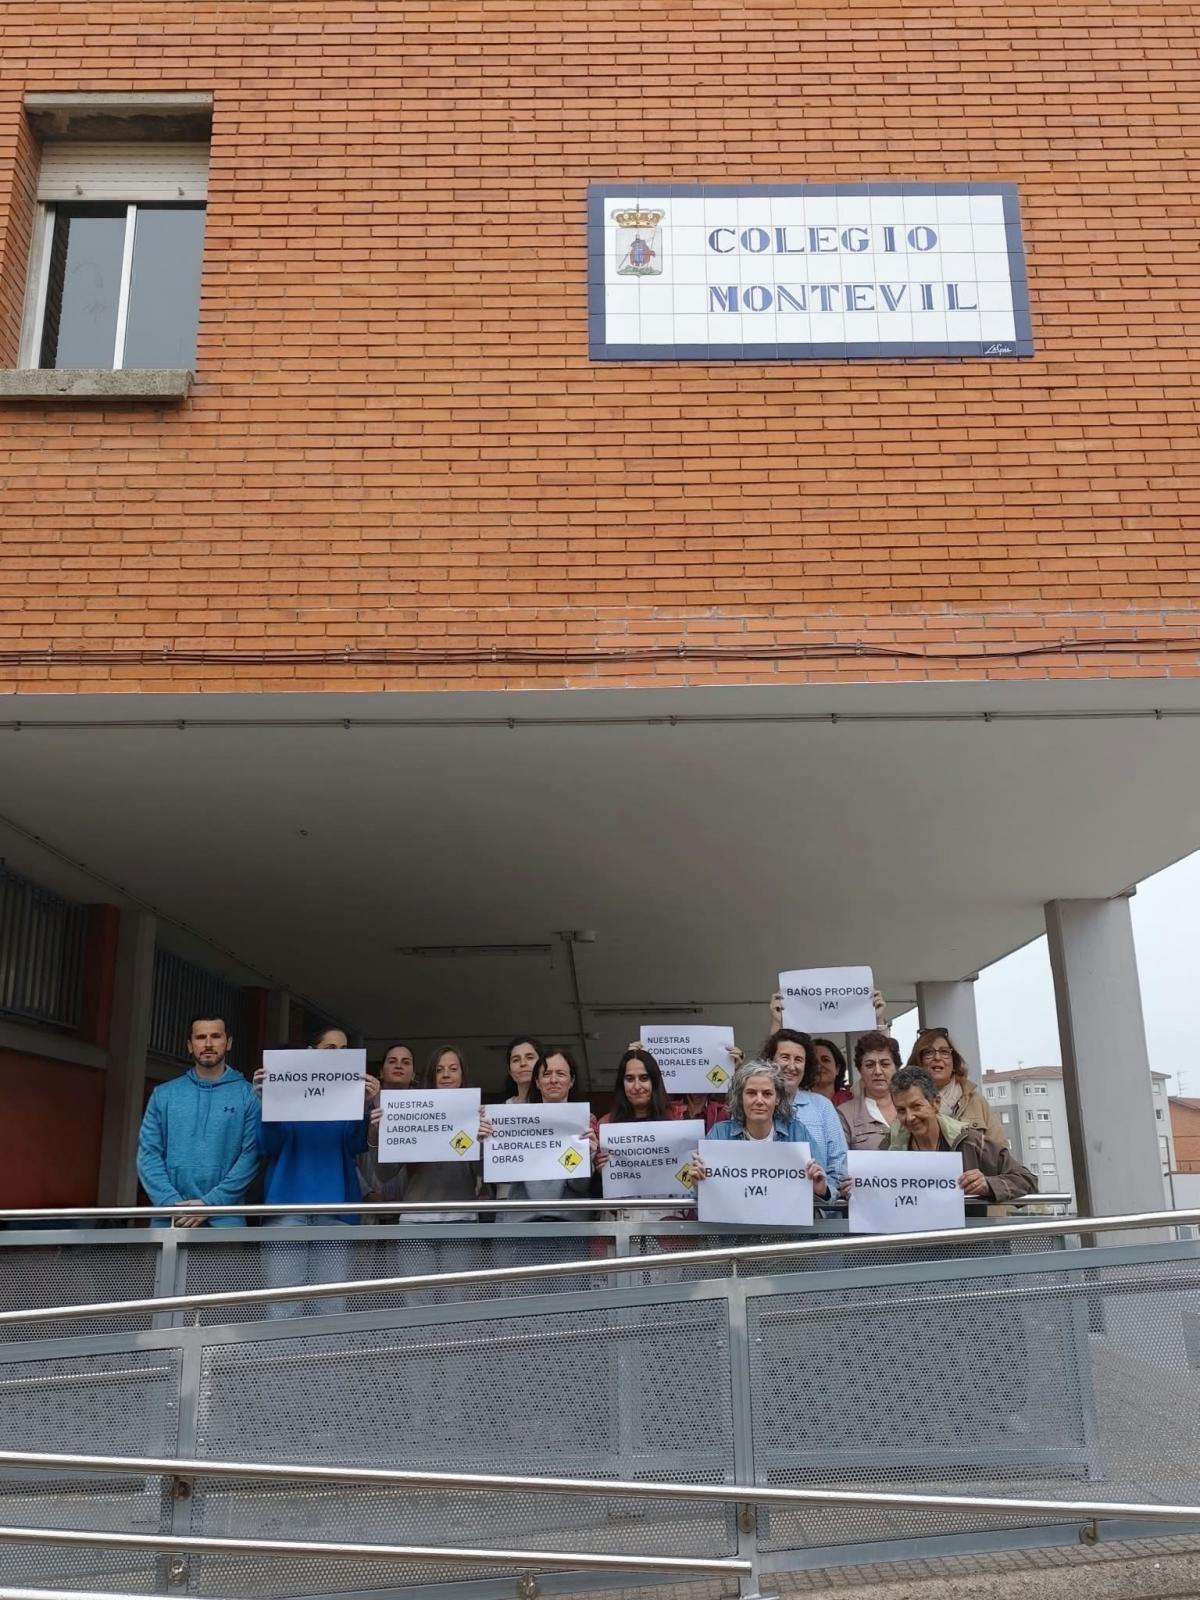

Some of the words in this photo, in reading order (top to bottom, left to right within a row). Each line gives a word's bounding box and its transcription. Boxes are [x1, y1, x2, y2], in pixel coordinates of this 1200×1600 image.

[708, 226, 938, 253] COLEGIO
[709, 283, 977, 312] MONTEVIL
[786, 986, 822, 997] BAÑOS
[824, 987, 870, 996] PROPIOS
[819, 1001, 839, 1011] ¡YA!
[647, 1036, 690, 1044] NUESTRAS
[698, 1058, 710, 1066] EN
[269, 1071, 308, 1082] BAÑOS
[311, 1072, 360, 1082] PROPIOS
[304, 1088, 325, 1098] ¡YA!
[387, 1100, 434, 1109] NUESTRAS
[387, 1112, 446, 1121] CONDICIONES
[491, 1116, 540, 1125] NUESTRAS
[387, 1124, 439, 1133] LABORALES
[441, 1124, 454, 1132] EN
[491, 1128, 554, 1138] CONDICIONES
[386, 1137, 417, 1145] OBRAS
[607, 1135, 656, 1144] NUESTRAS
[492, 1141, 547, 1150] LABORALES
[549, 1140, 562, 1148] EN
[608, 1146, 670, 1156] CONDICIONES
[492, 1155, 524, 1164] OBRAS
[609, 1159, 663, 1168] LABORALES
[666, 1157, 678, 1165] EN
[610, 1171, 641, 1180] OBRAS
[705, 1165, 748, 1178] BAÑOS
[751, 1168, 806, 1179] PROPIOS
[855, 1175, 898, 1188] BAÑOS
[901, 1178, 956, 1190] PROPIOS
[744, 1186, 767, 1198] ¡YA!
[895, 1196, 918, 1207] ¡YA!
